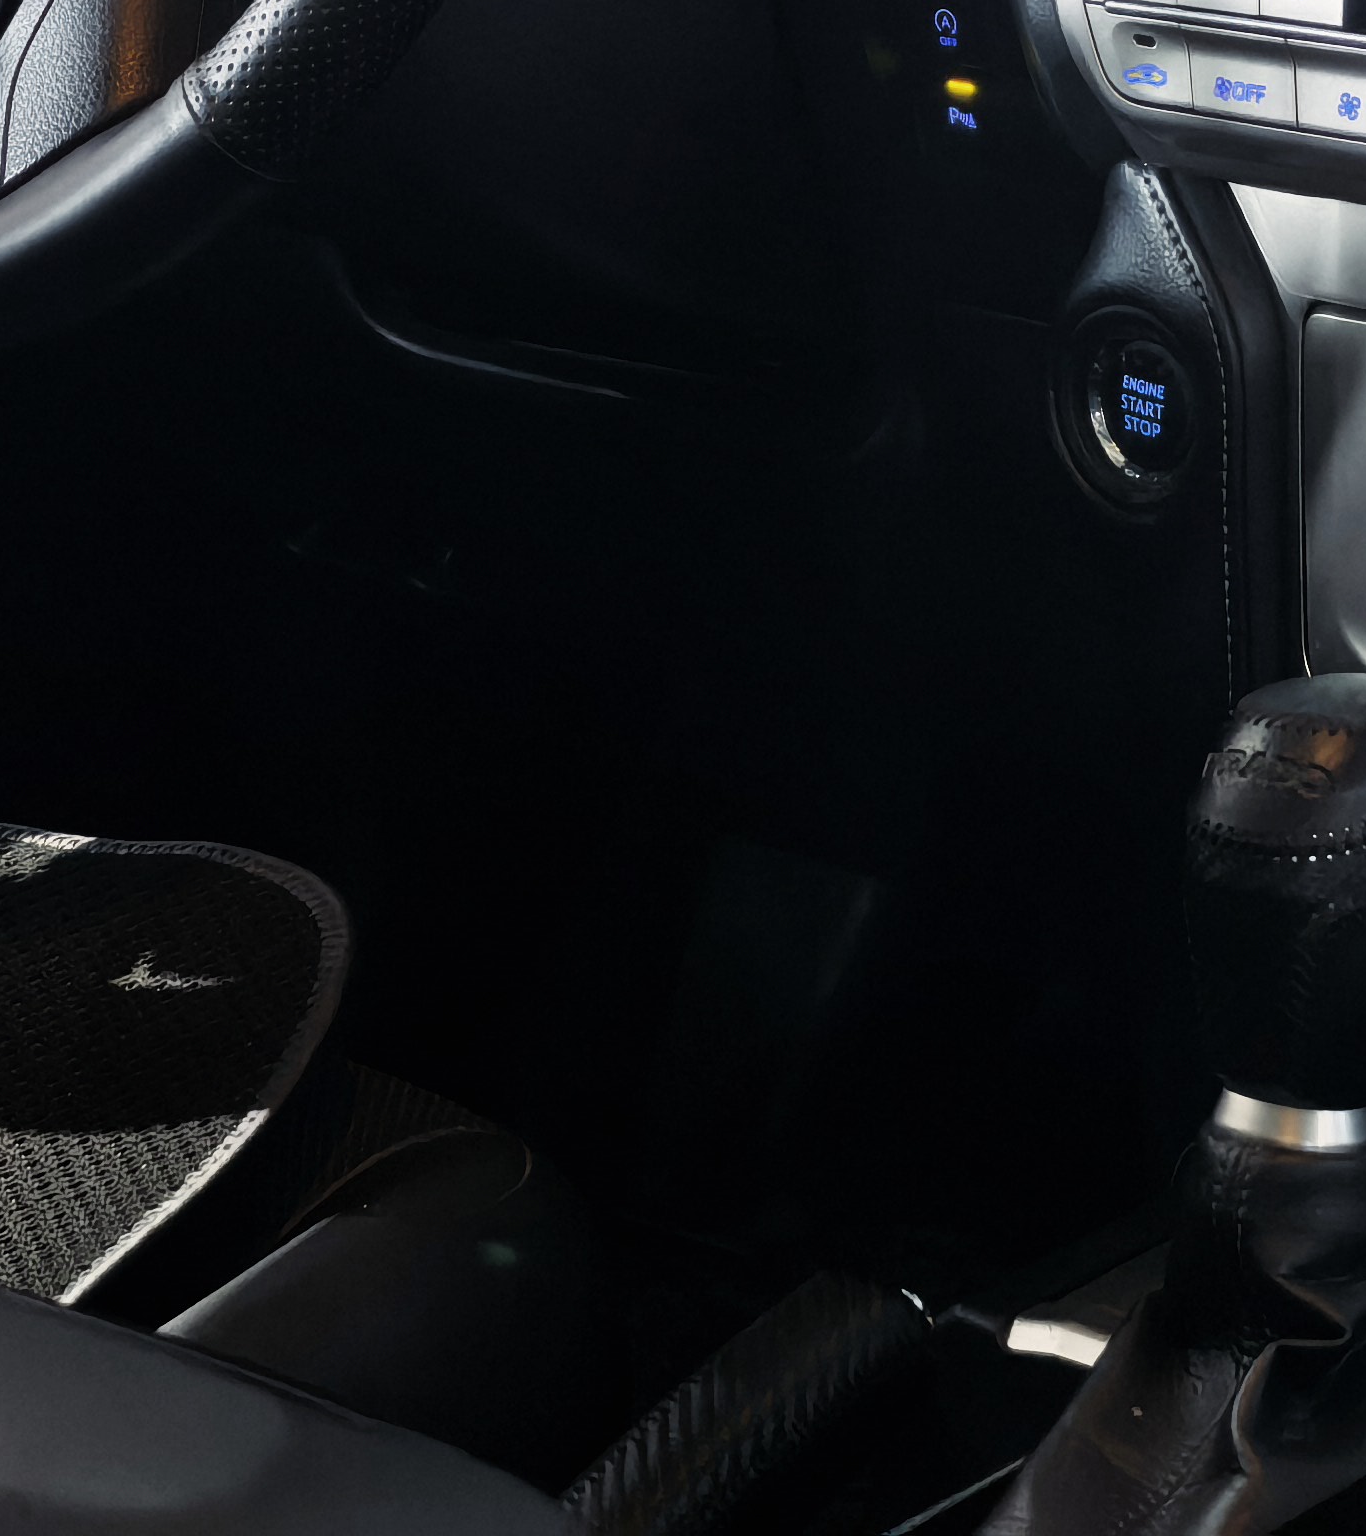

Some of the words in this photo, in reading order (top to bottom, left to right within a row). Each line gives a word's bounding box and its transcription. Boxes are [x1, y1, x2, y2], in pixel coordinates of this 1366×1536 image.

[1232, 81, 1267, 105] OFF
[1122, 374, 1165, 401] ENGINE
[1120, 394, 1165, 420] START
[1124, 414, 1161, 438] STOP
